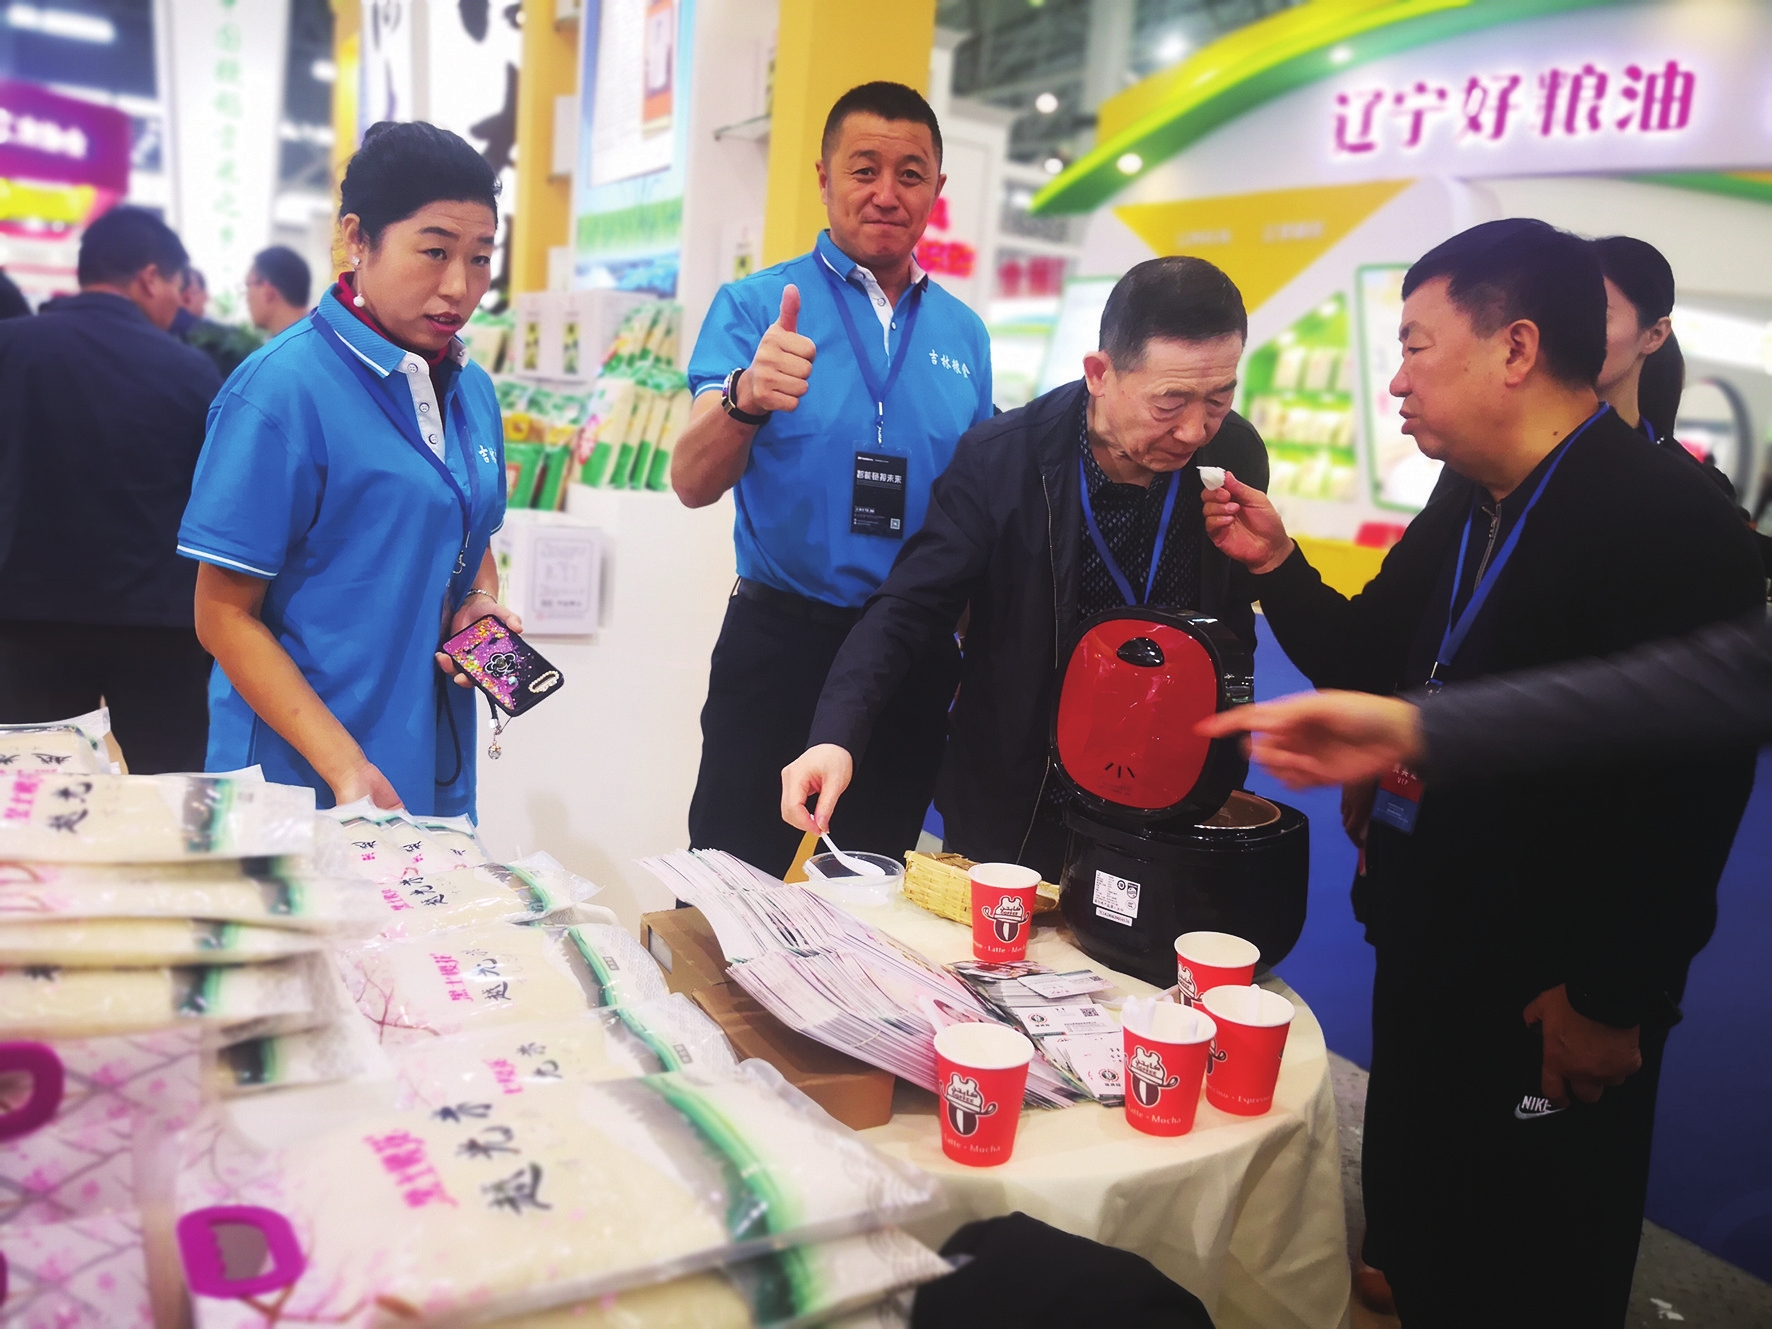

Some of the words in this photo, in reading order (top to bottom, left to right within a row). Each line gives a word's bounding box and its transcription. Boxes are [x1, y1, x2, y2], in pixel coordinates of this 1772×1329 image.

[1332, 60, 1696, 155] 辽宁好粮油
[987, 945, 1006, 953] Latte
[1127, 1103, 1144, 1119] Latte
[1151, 1114, 1182, 1125] Mocha
[1521, 1095, 1552, 1114] NIKE
[944, 1133, 961, 1149] Latte
[969, 1143, 1001, 1153] Mocha
